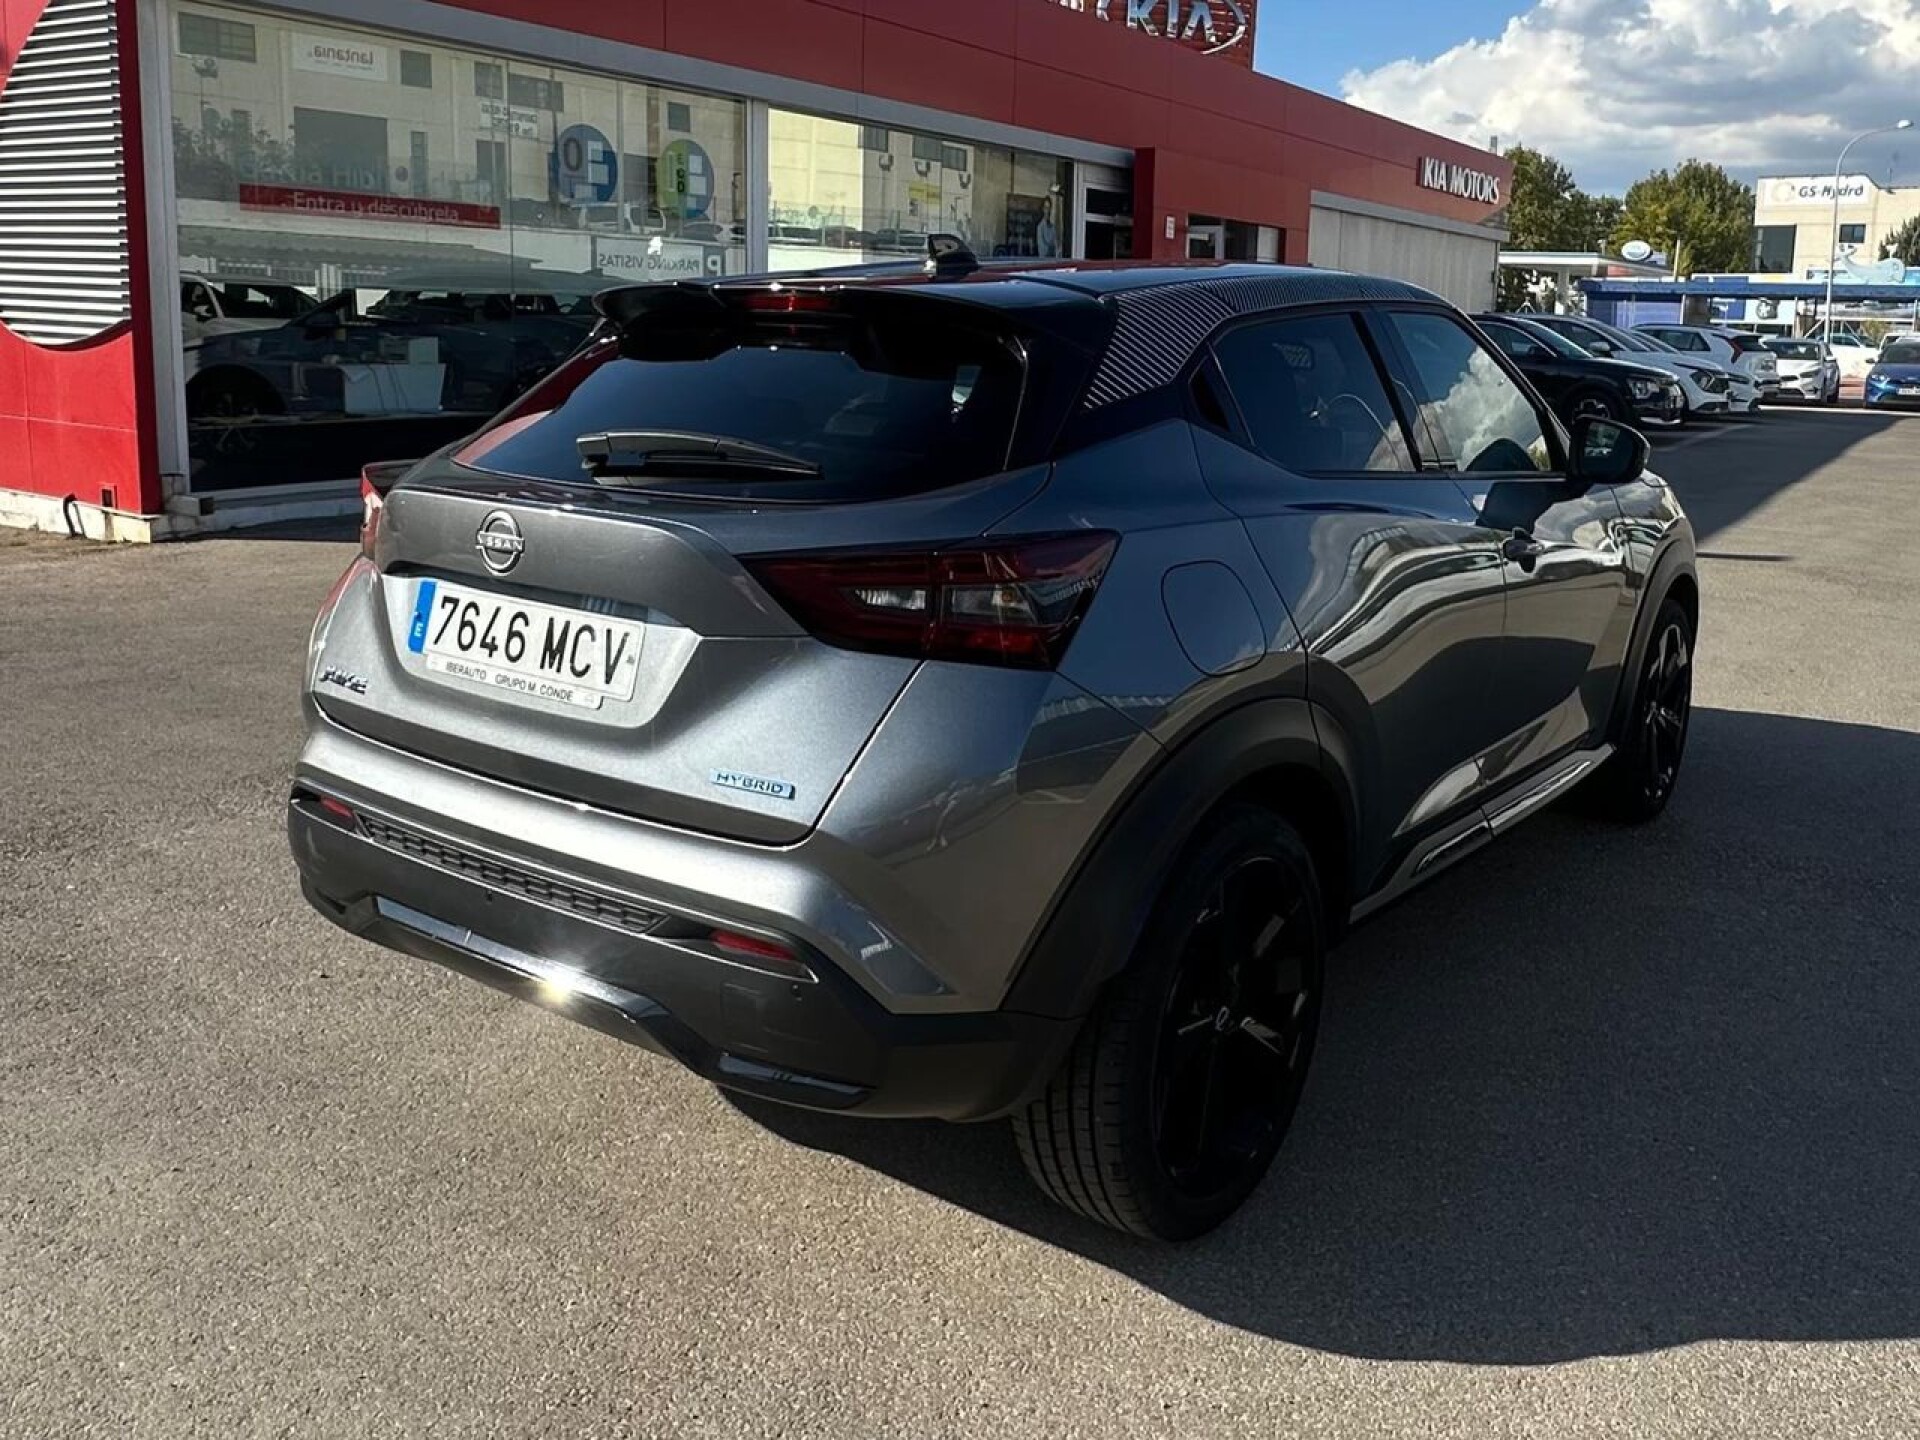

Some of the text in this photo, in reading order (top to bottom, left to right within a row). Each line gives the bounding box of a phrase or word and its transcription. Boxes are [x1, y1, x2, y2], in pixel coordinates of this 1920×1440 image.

[1127, 0, 1221, 45] KIA
[1424, 156, 1500, 205] KIA MOTORS
[293, 191, 346, 214] Entra
[477, 532, 524, 551] SSAN
[414, 623, 424, 637] E
[433, 596, 630, 685] 7646 MCV
[446, 661, 487, 680] IBERAUTO
[495, 673, 526, 691] GRUPO
[539, 684, 574, 702] CONDE
[716, 773, 784, 793] HYBRID
